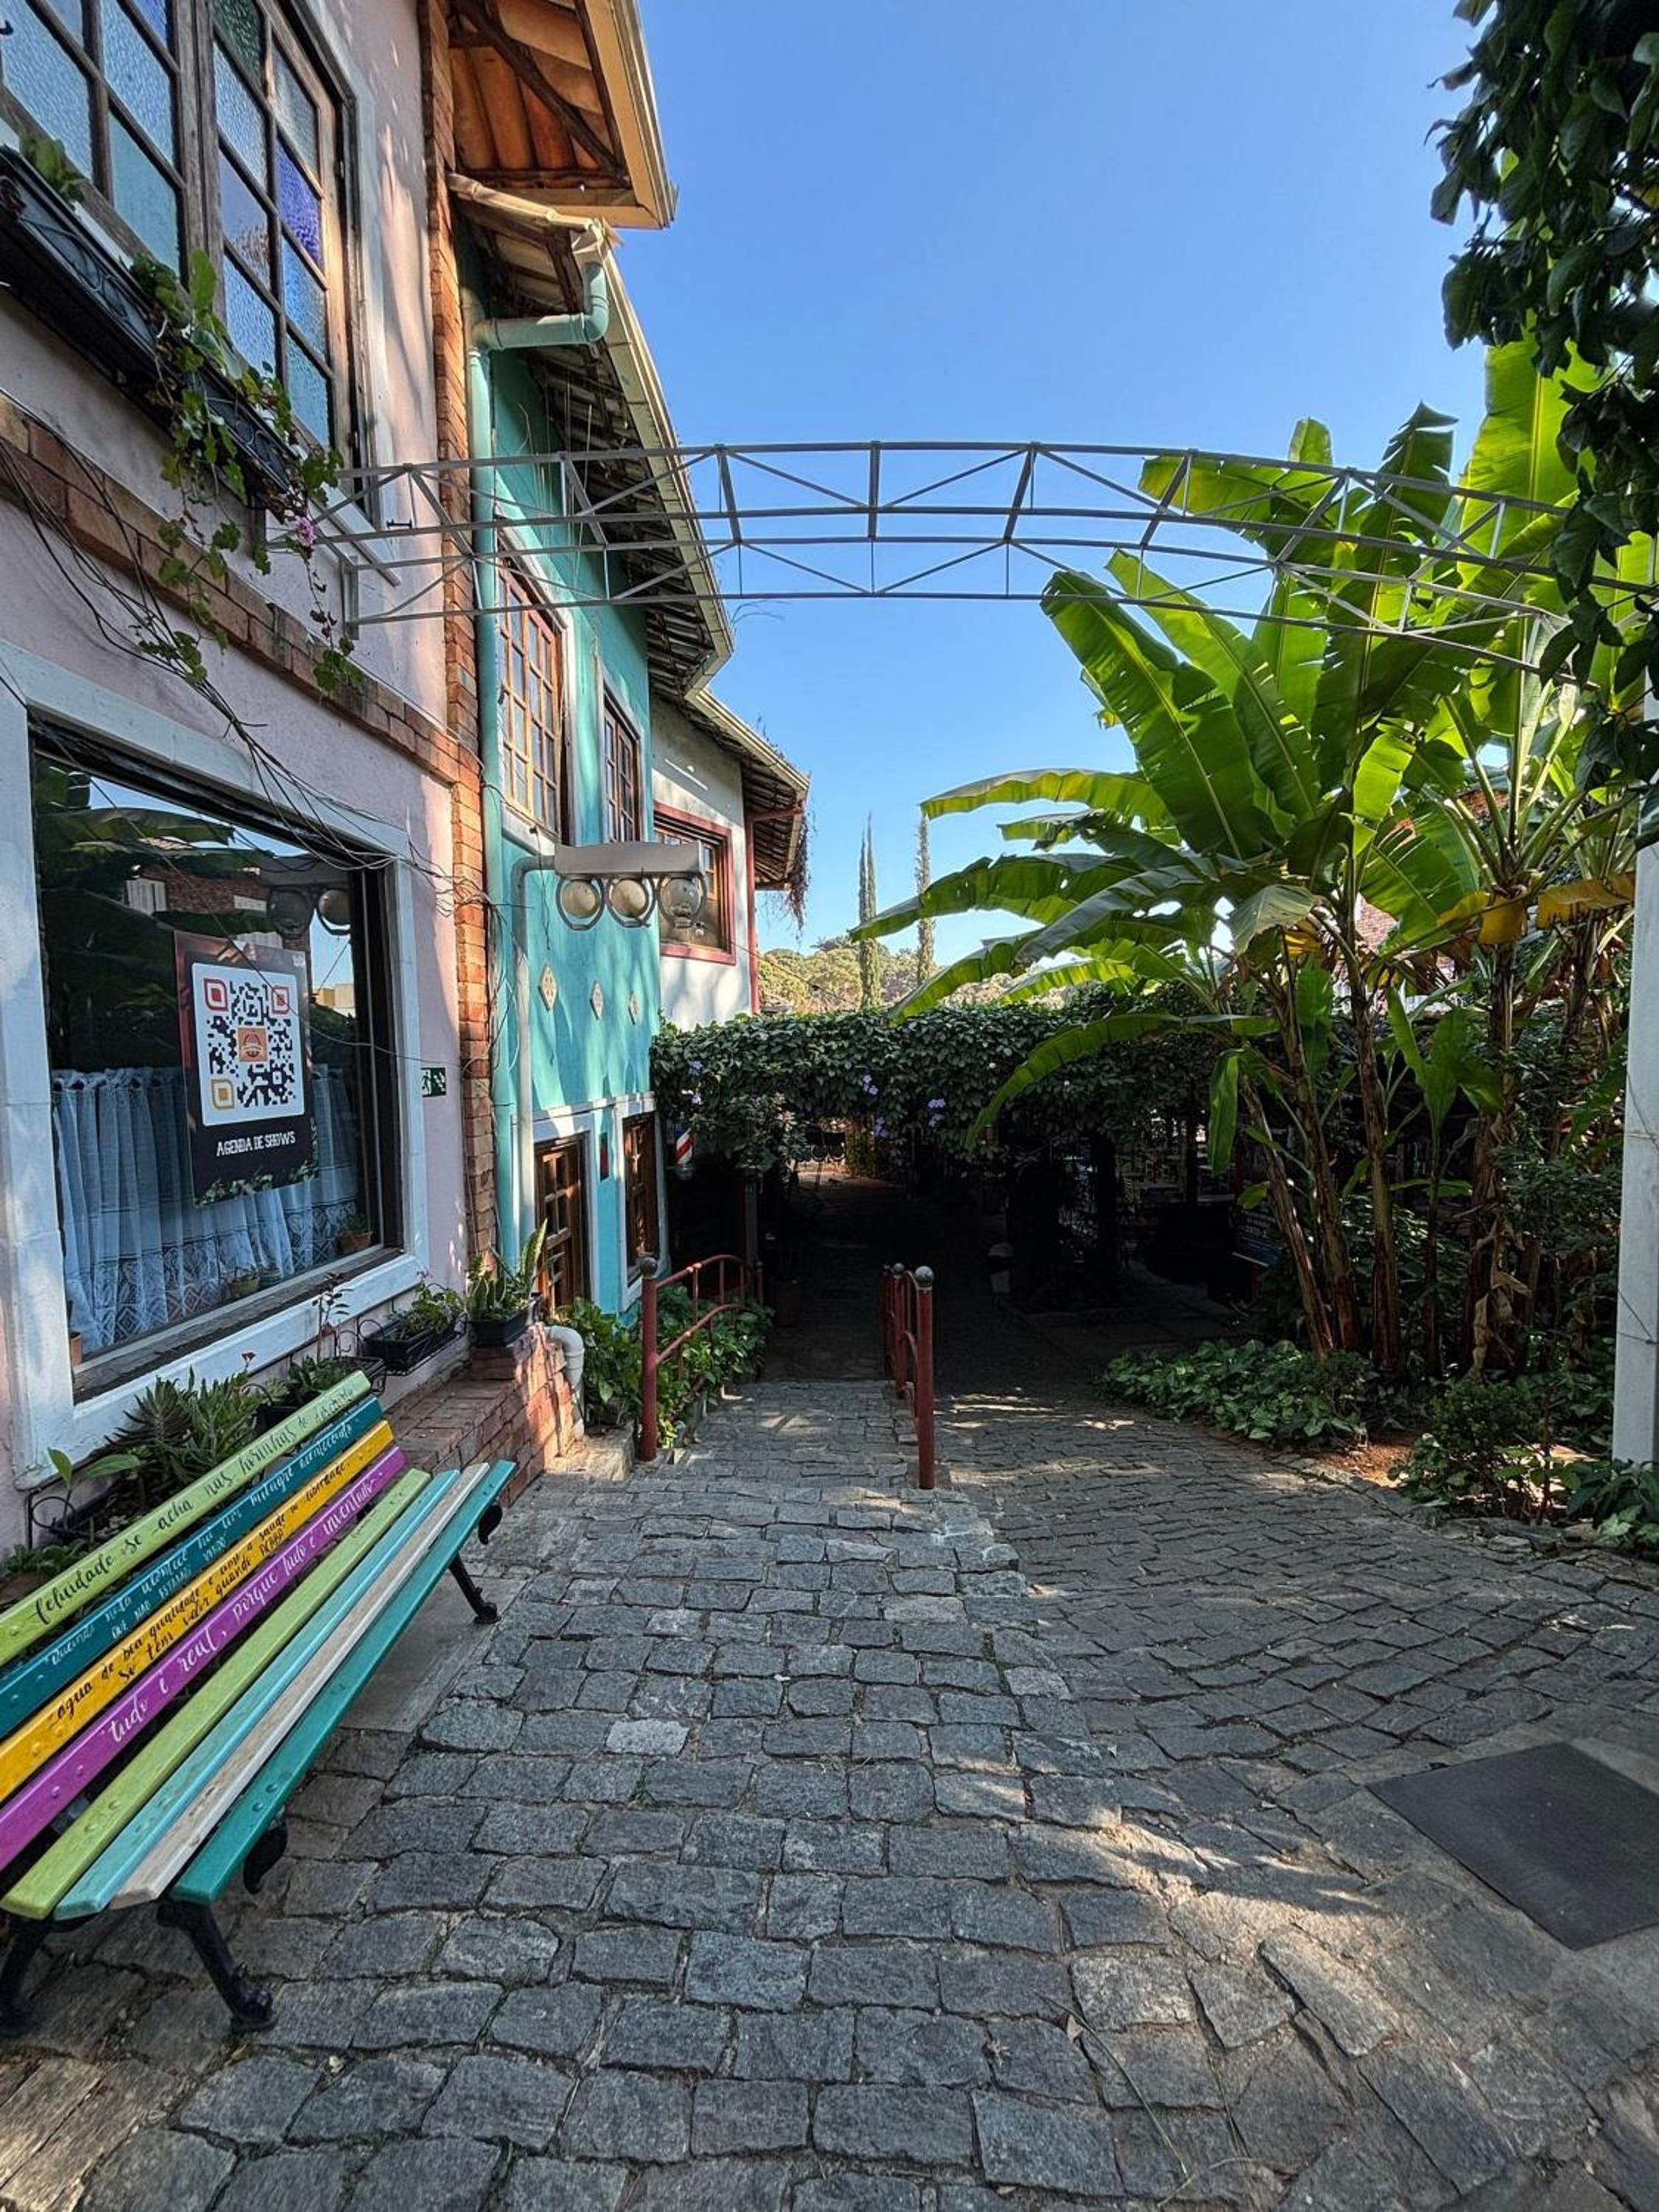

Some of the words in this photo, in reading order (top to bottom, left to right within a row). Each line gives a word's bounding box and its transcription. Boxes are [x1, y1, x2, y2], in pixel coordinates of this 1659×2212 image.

[216, 1137, 252, 1156] AGENDA
[253, 1135, 264, 1150] DE
[265, 1131, 295, 1148] SHOWS
[156, 1499, 193, 1531] acha
[204, 1471, 236, 1498] nas
